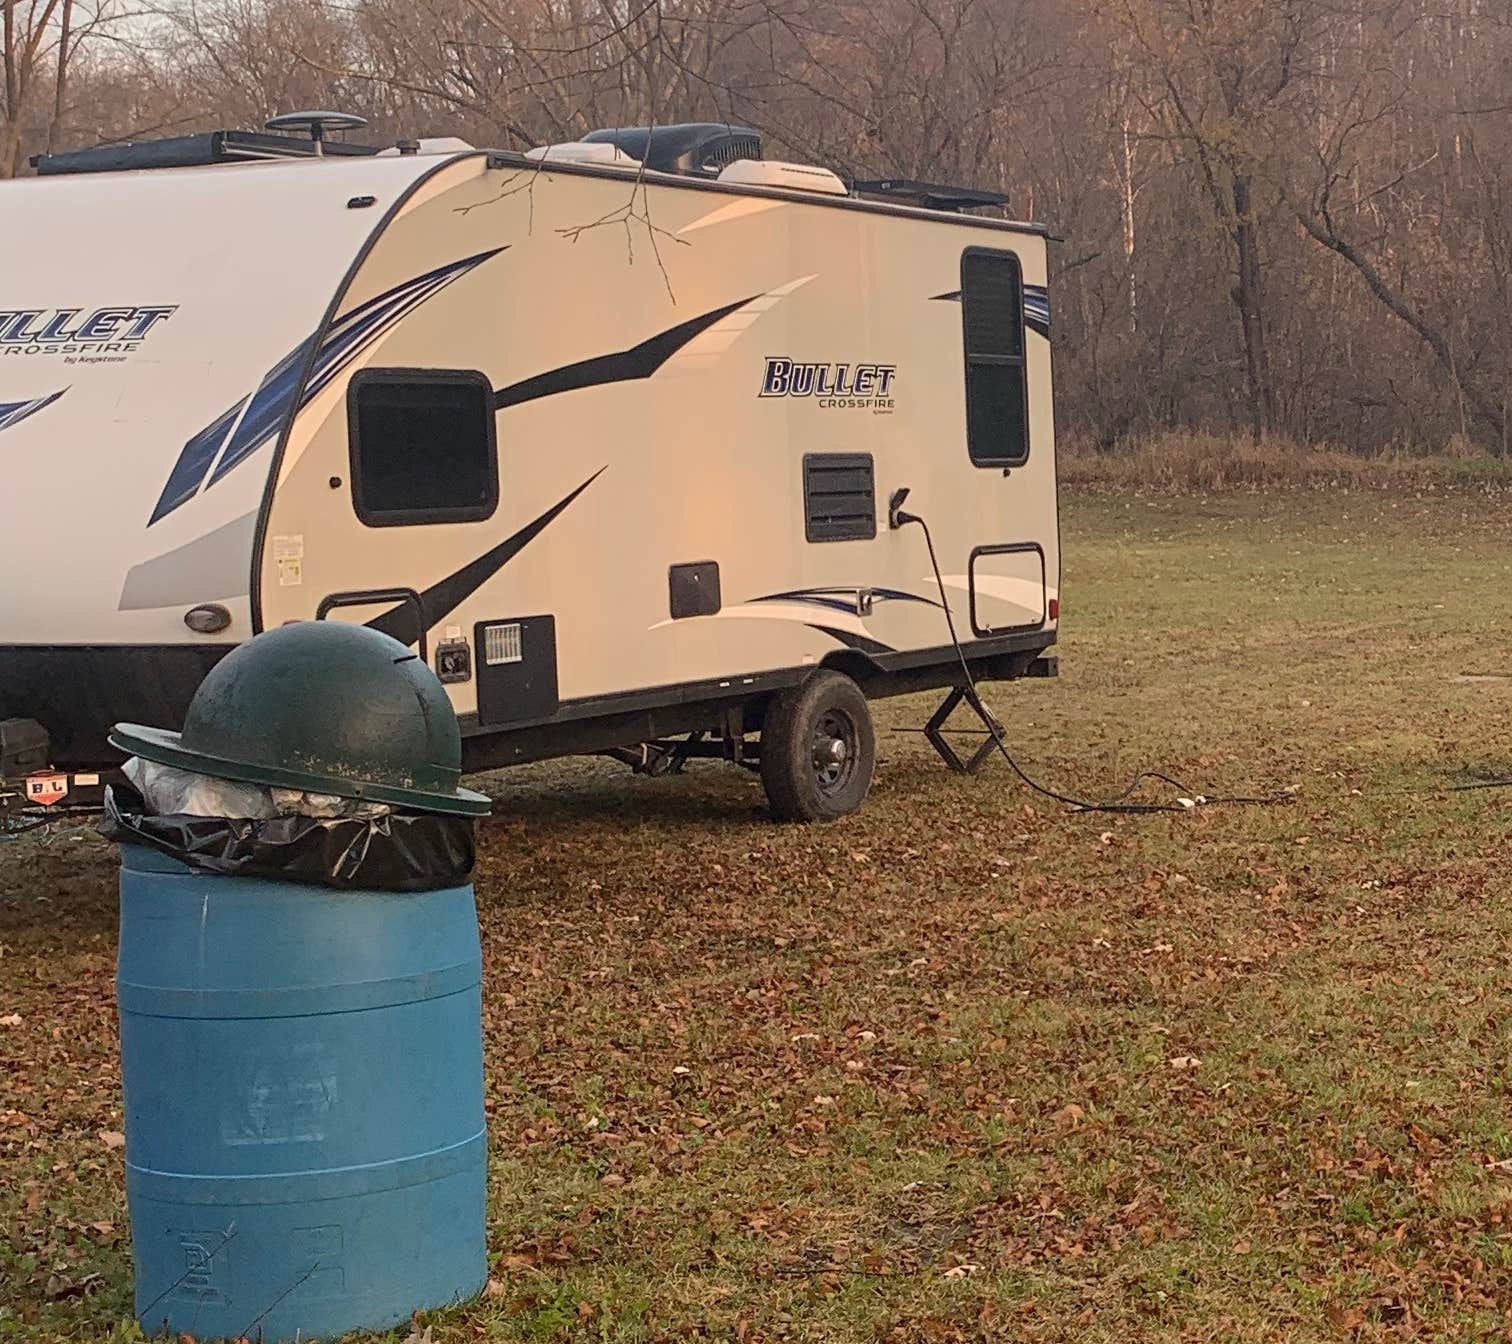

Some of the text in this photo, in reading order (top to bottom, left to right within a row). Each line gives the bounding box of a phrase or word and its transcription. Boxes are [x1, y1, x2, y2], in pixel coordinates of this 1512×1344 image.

[0, 342, 141, 356] ROSSFIRE
[64, 356, 127, 365] by Keystone
[758, 356, 897, 397] BULLET
[818, 399, 895, 409] CROSSFIRE
